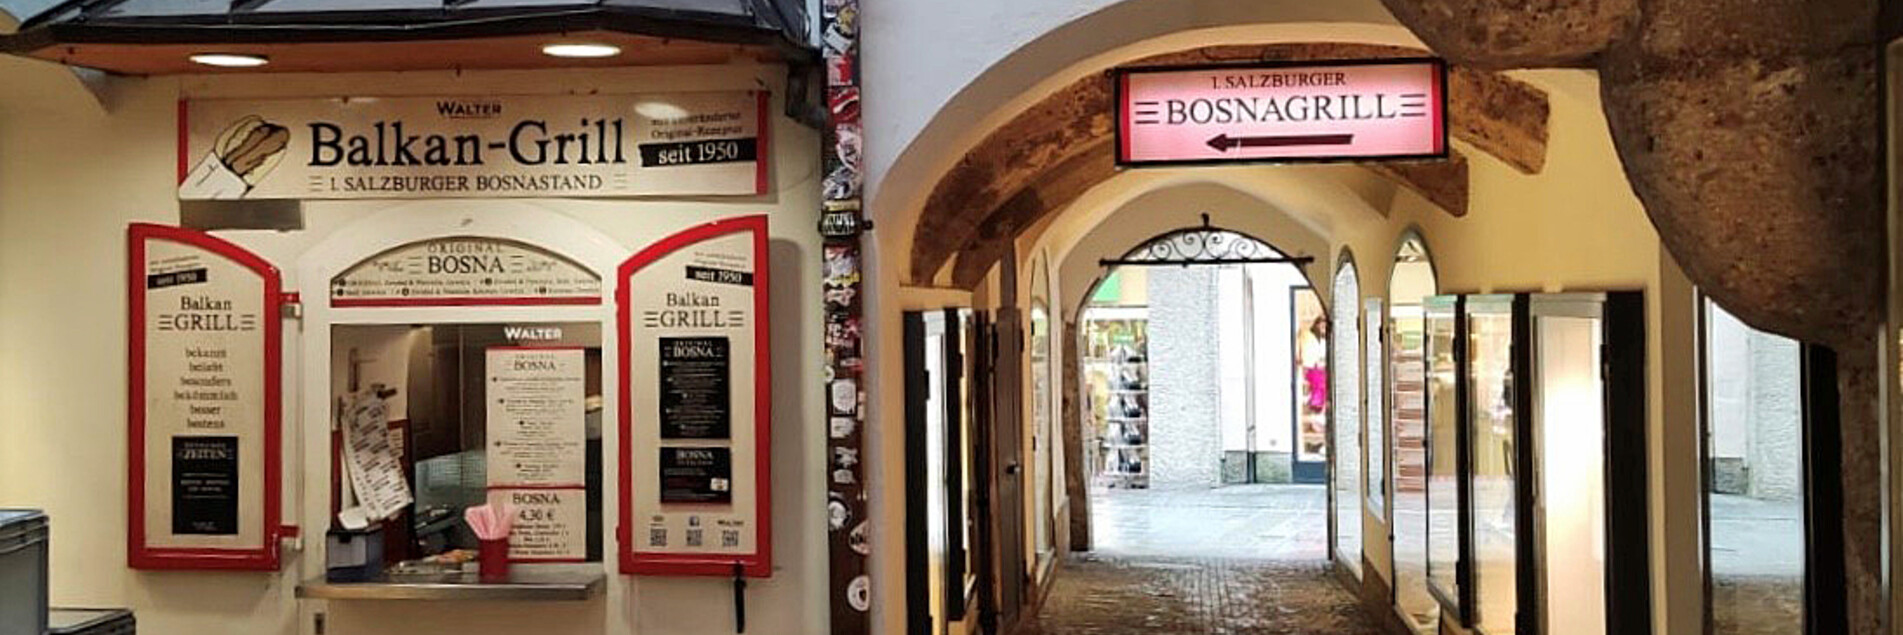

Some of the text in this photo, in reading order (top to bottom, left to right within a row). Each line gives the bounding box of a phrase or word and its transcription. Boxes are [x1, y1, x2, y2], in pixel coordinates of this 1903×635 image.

[1223, 72, 1347, 89] SALZBURGER
[437, 101, 502, 115] WALTER
[1166, 93, 1397, 125] BOSNAGRILL
[307, 118, 627, 167] Balkan-Grill
[658, 141, 740, 165] seit 1950
[344, 176, 470, 192] SALZBURGER
[477, 174, 603, 191] BOSNASTAND
[427, 241, 503, 254] ORIGINAL
[428, 255, 504, 274] BOSNA
[694, 269, 742, 283] seit 1950
[181, 295, 232, 311] Balkan
[666, 292, 720, 307] Balkan
[174, 313, 239, 331] GRILL
[660, 310, 727, 328] GRILL
[504, 326, 562, 340] WALTER
[185, 347, 227, 359] bekannt
[674, 346, 715, 357] BOSNA
[513, 359, 557, 371] BOSNA
[512, 492, 561, 505] BOSNA
